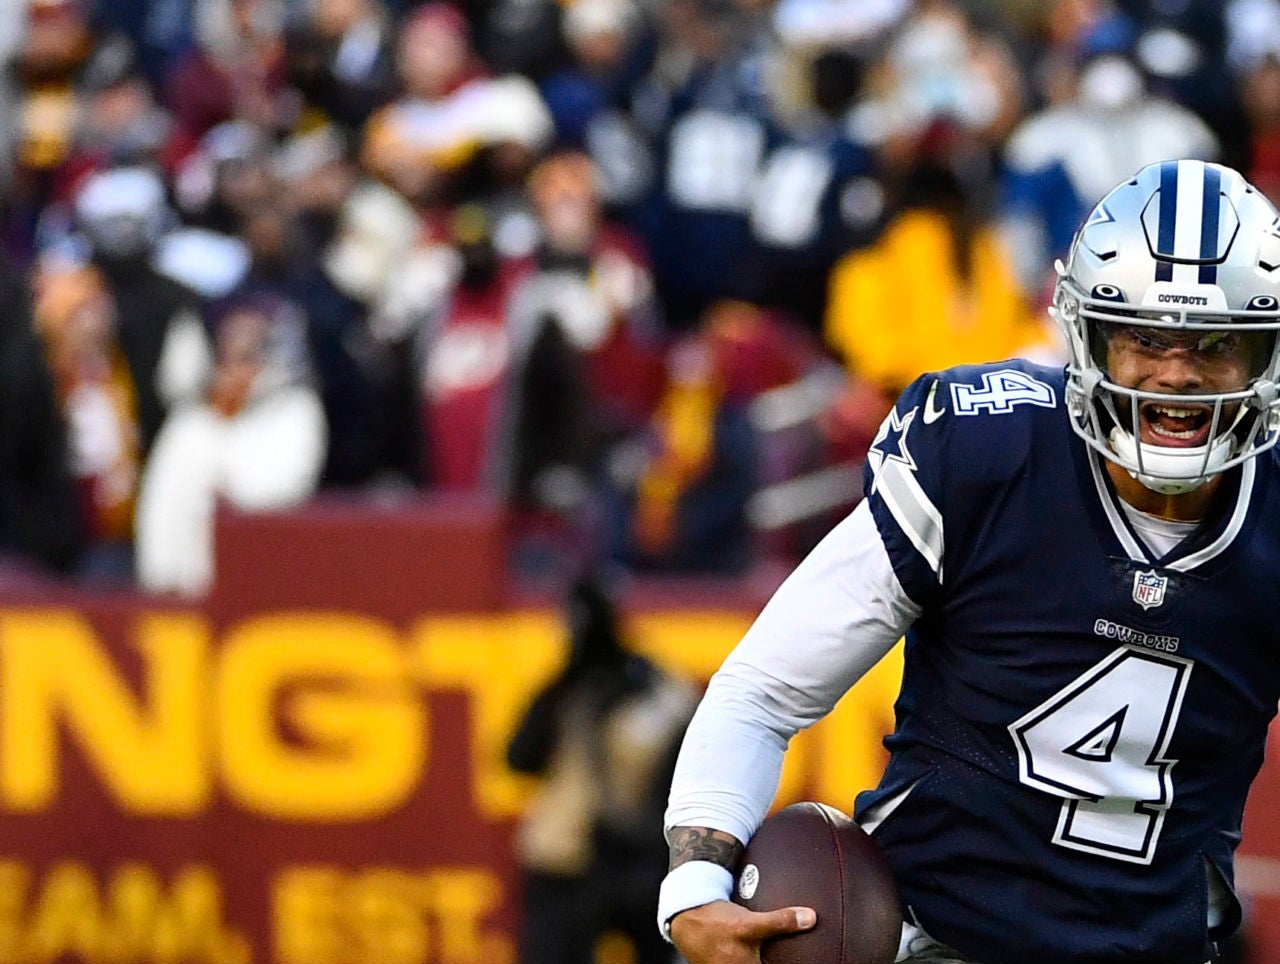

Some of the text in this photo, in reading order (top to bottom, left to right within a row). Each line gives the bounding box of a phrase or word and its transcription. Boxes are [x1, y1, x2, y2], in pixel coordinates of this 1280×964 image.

[1157, 293, 1209, 307] COWBOYS
[949, 369, 1057, 417] 4
[1138, 585, 1158, 603] NFL
[1093, 618, 1180, 653] COWBOYS
[1006, 645, 1194, 866] 4
